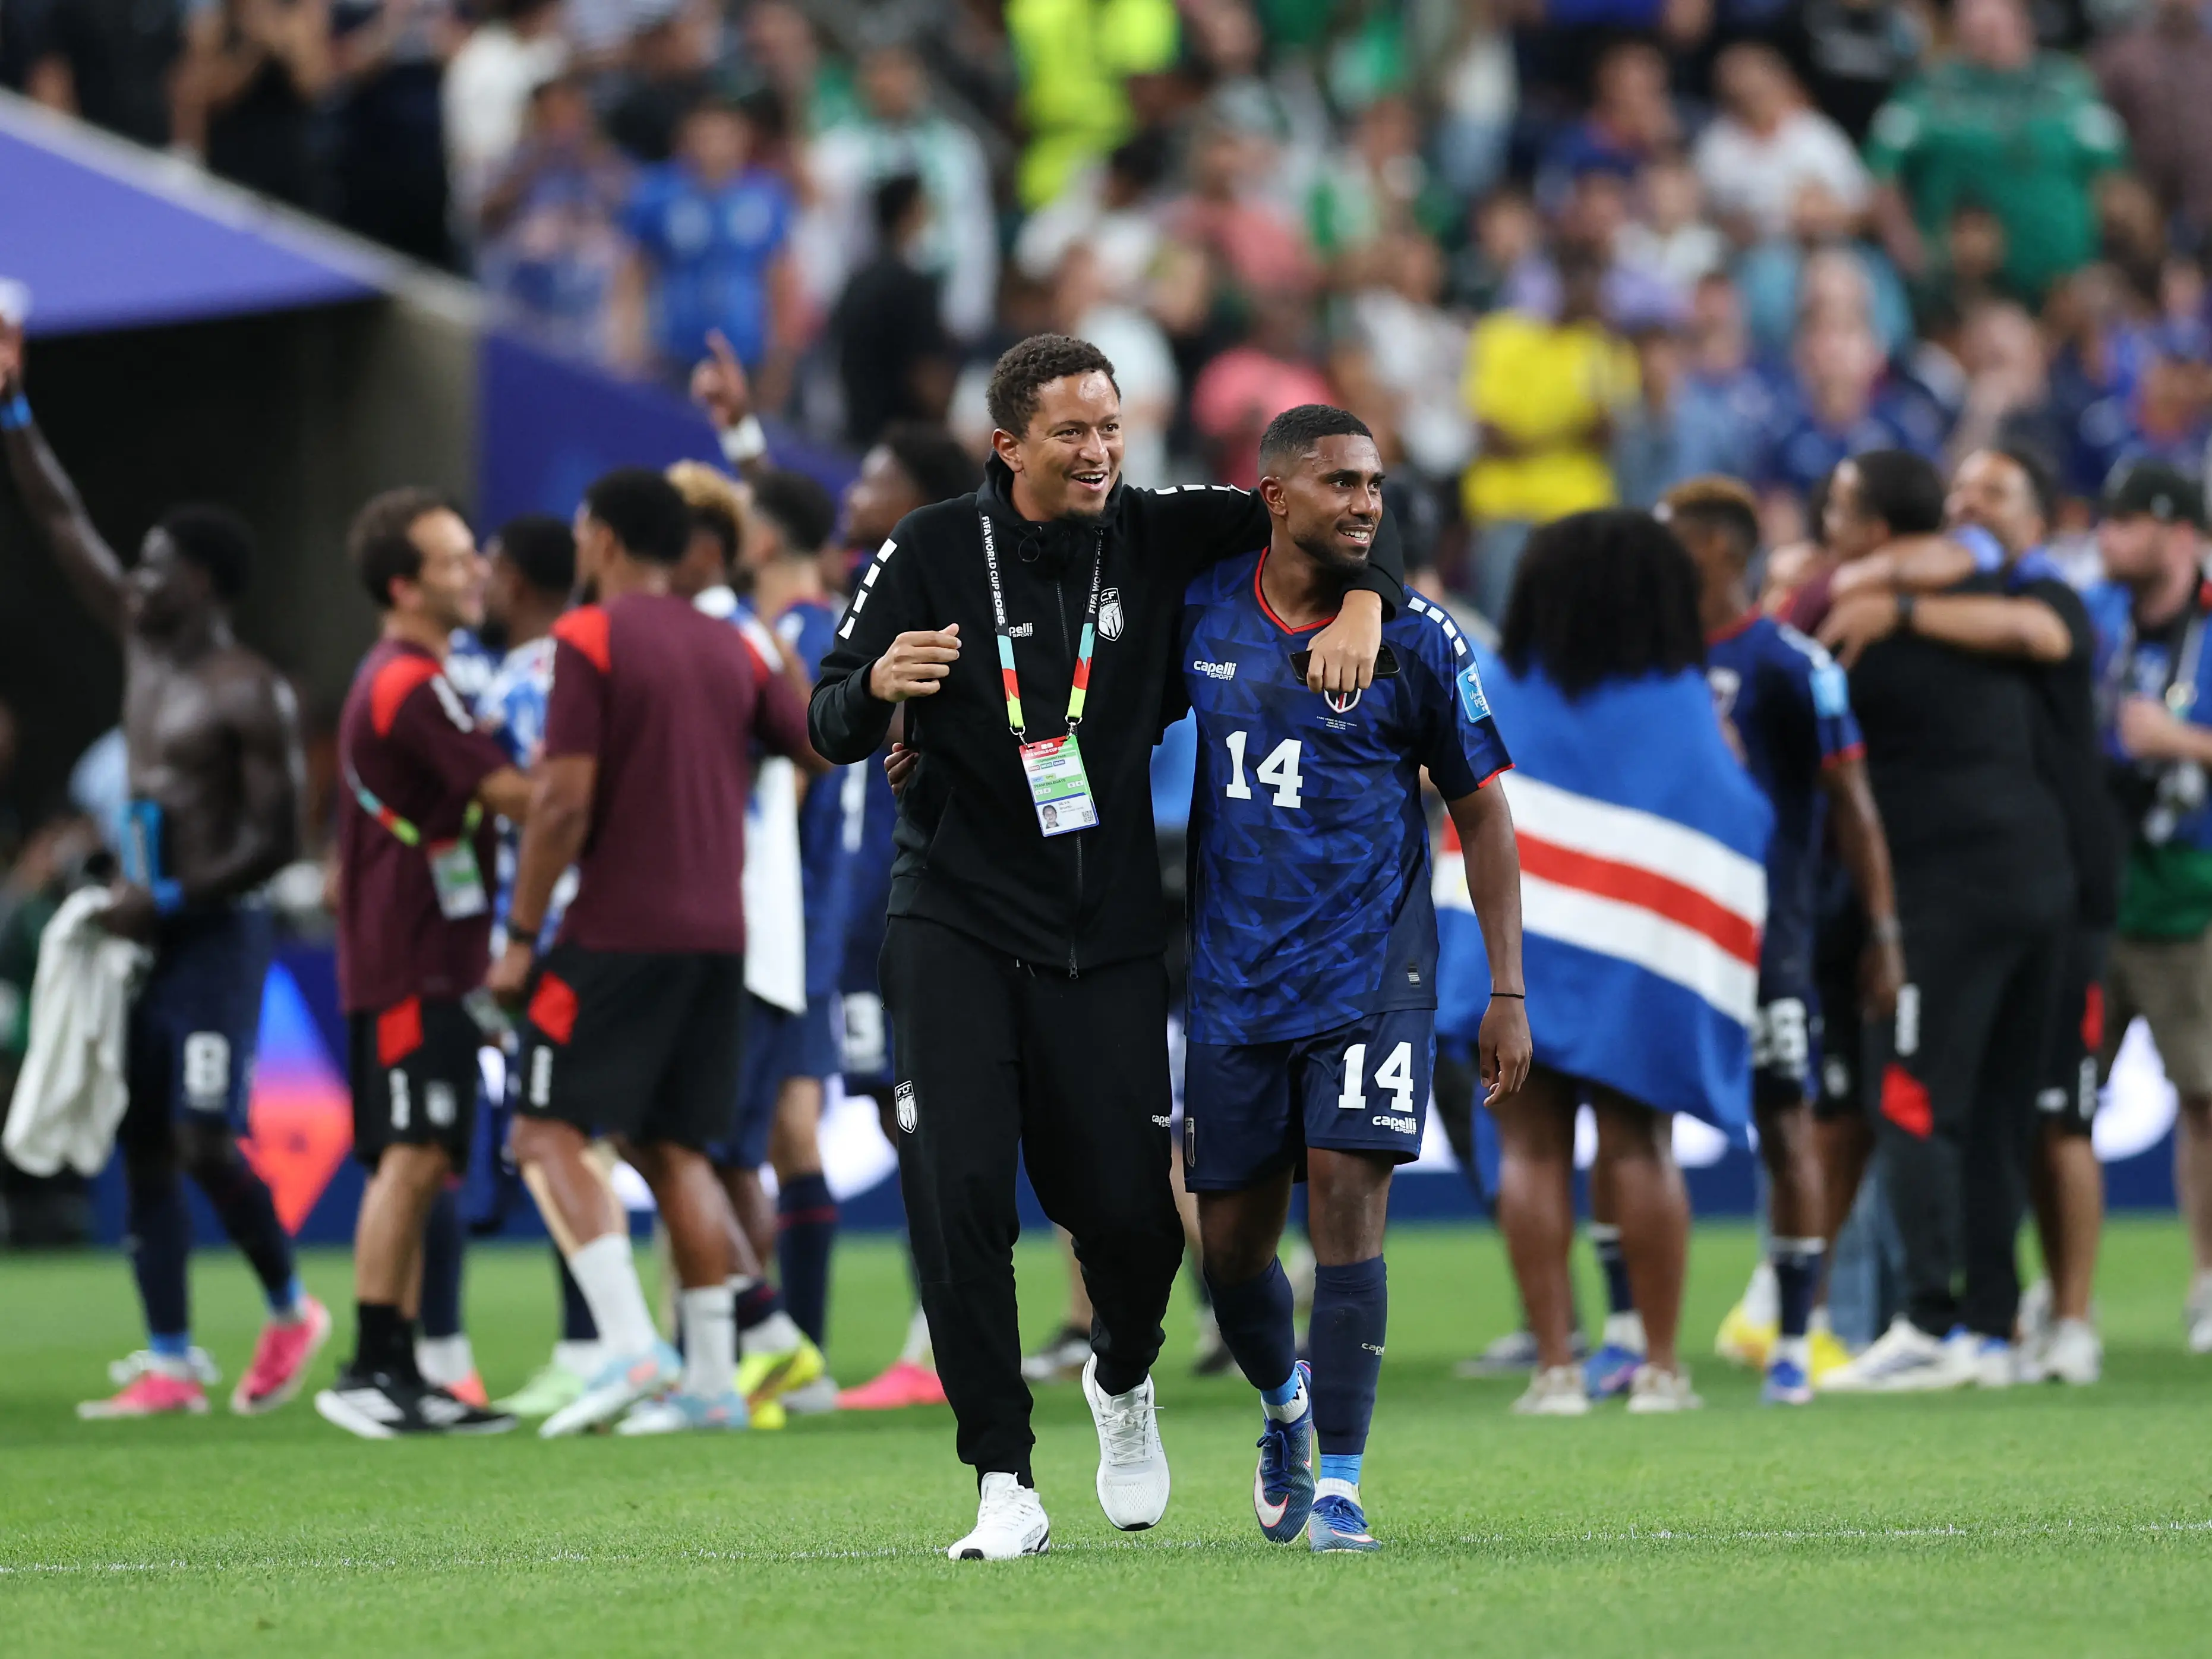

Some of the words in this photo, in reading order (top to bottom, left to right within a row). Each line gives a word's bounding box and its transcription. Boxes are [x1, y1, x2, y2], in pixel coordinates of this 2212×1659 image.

[982, 516, 992, 536] FIFA
[984, 535, 996, 569] WORLD
[990, 570, 999, 590] CUP
[1088, 594, 1099, 614] FIFA
[1100, 591, 1116, 602] CF
[993, 591, 1005, 625] 2026
[1008, 622, 1033, 636] pelli
[1194, 660, 1237, 676] capelli
[1226, 730, 1304, 809] 14
[1338, 1042, 1413, 1113] 14
[1152, 1114, 1171, 1125] capel
[1372, 1116, 1416, 1131] capelli
[1394, 1126, 1416, 1135] SPORT
[1361, 1343, 1385, 1355] cape
